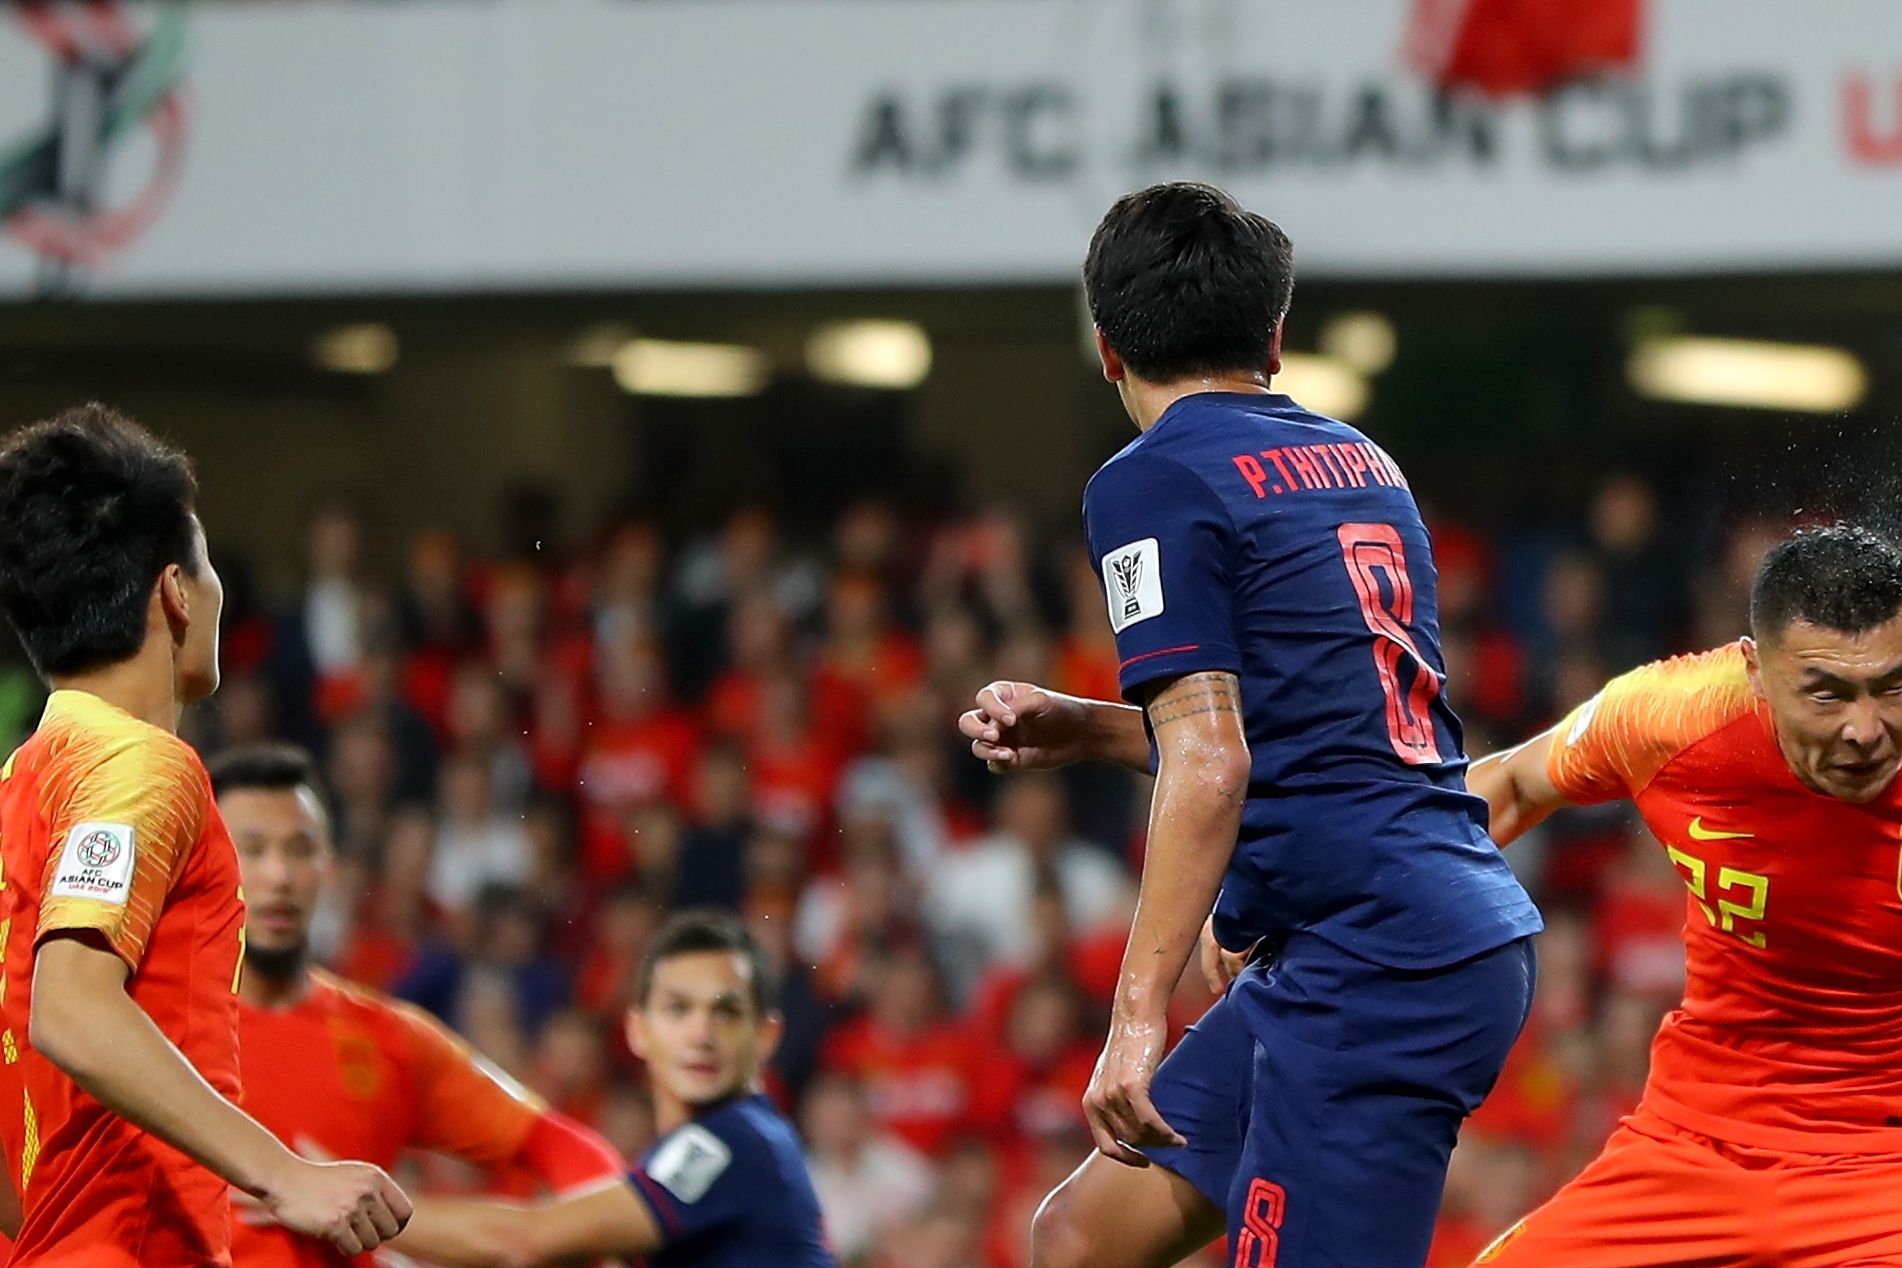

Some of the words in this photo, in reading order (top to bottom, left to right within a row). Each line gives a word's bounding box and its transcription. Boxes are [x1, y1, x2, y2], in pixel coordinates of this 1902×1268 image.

[850, 80, 1075, 177] AFC
[1138, 74, 1497, 173] ASIAN
[1540, 72, 1792, 171] CUP
[1337, 522, 1446, 765] 8
[60, 875, 96, 885] ASIAN
[98, 878, 124, 889] CUP
[82, 868, 102, 877] AFC
